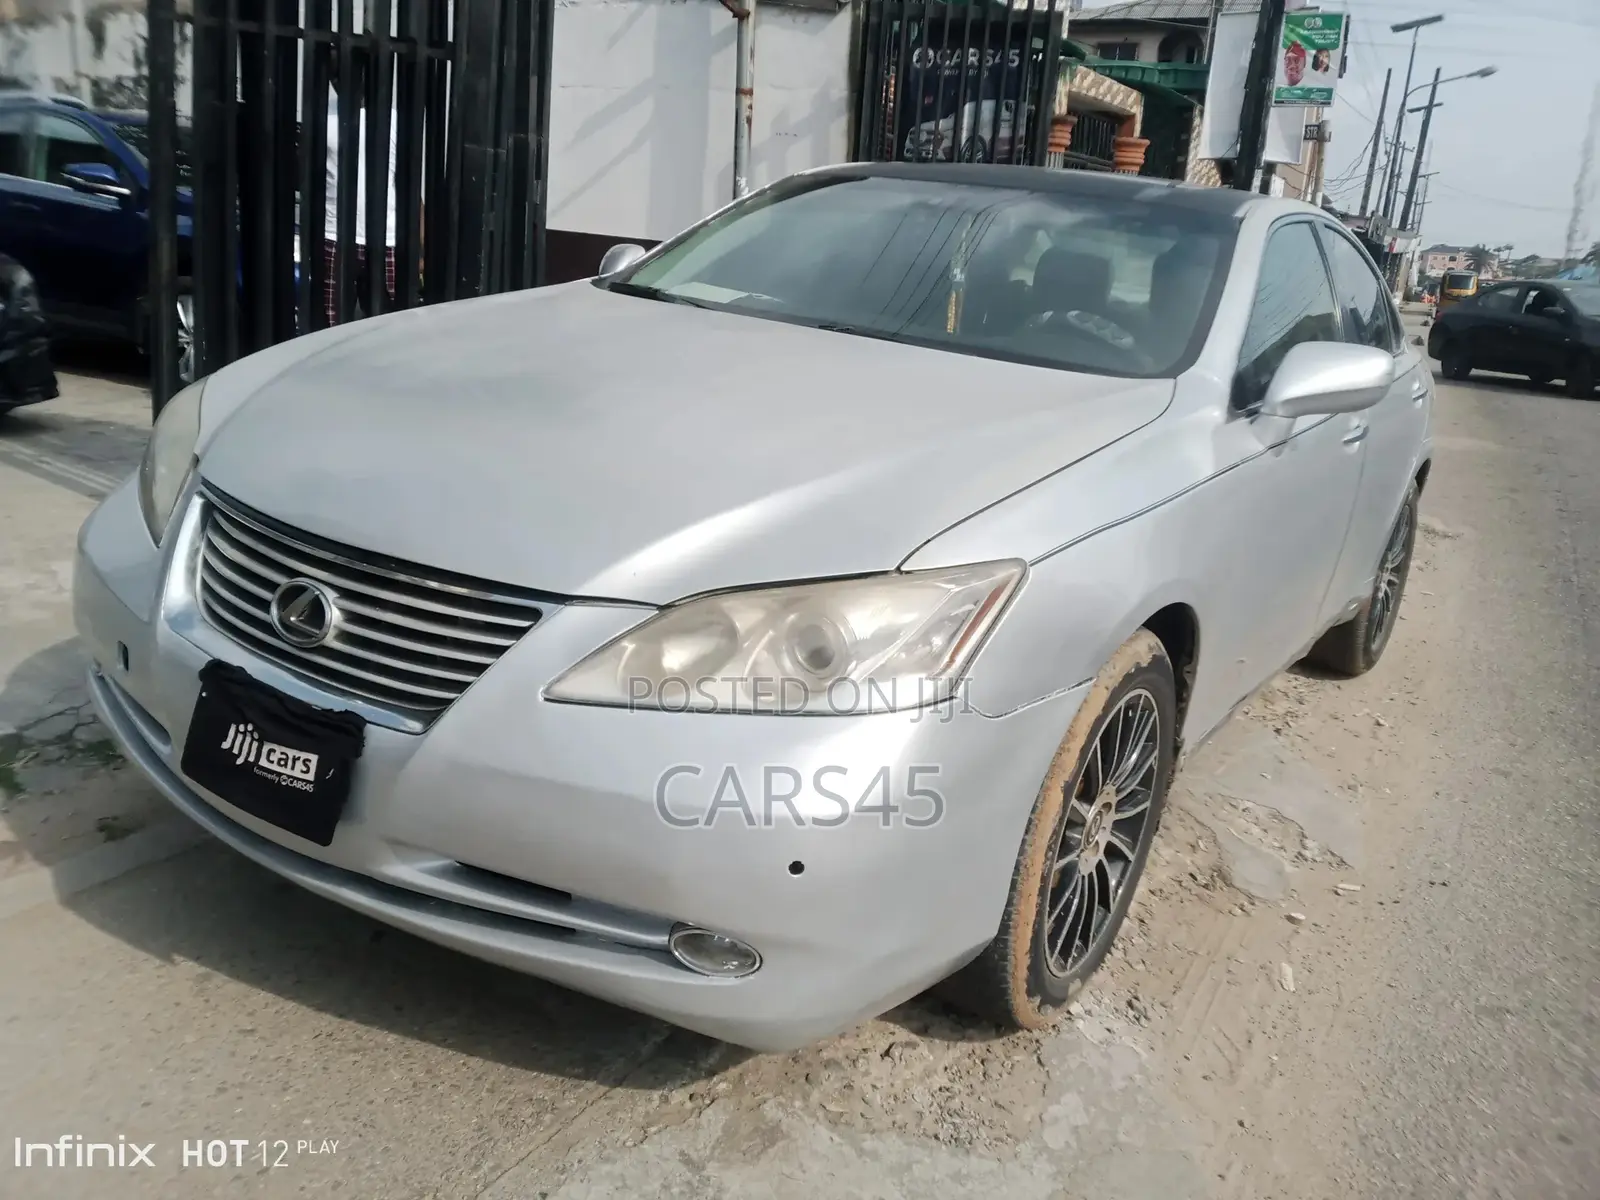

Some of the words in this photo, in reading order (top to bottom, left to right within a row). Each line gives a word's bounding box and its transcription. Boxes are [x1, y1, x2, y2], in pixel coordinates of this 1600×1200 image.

[220, 722, 259, 766] Jiji
[265, 747, 312, 775] cars
[253, 766, 280, 784] formerly
